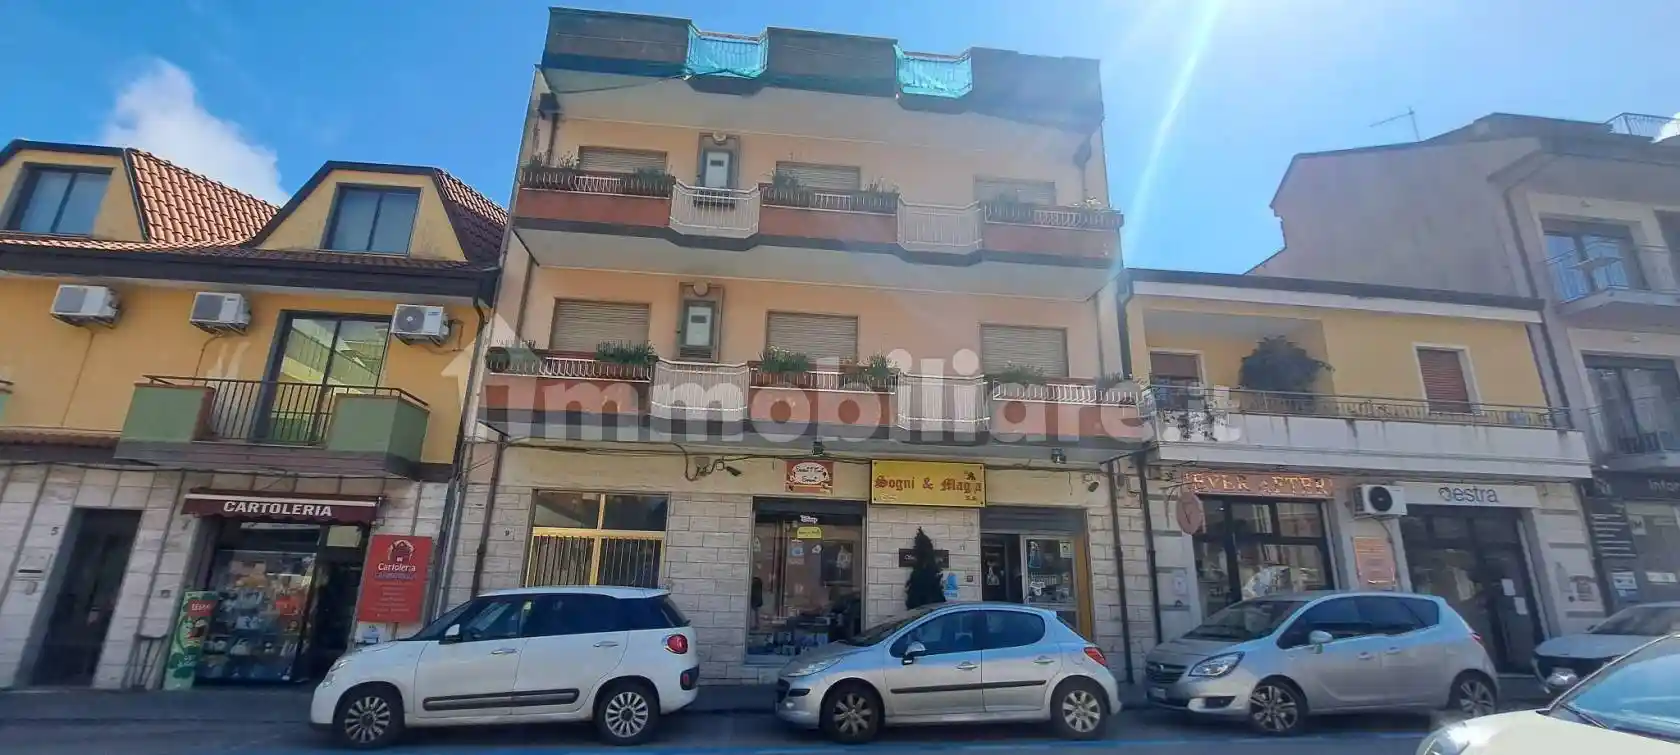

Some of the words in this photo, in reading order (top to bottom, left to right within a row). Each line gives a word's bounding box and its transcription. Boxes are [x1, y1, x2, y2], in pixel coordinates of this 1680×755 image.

[874, 475, 915, 491] Sogni
[922, 477, 934, 490] &
[1193, 473, 1250, 493] EVER
[223, 500, 333, 517] CARTOLERIA
[378, 562, 416, 572] Cartoleria
